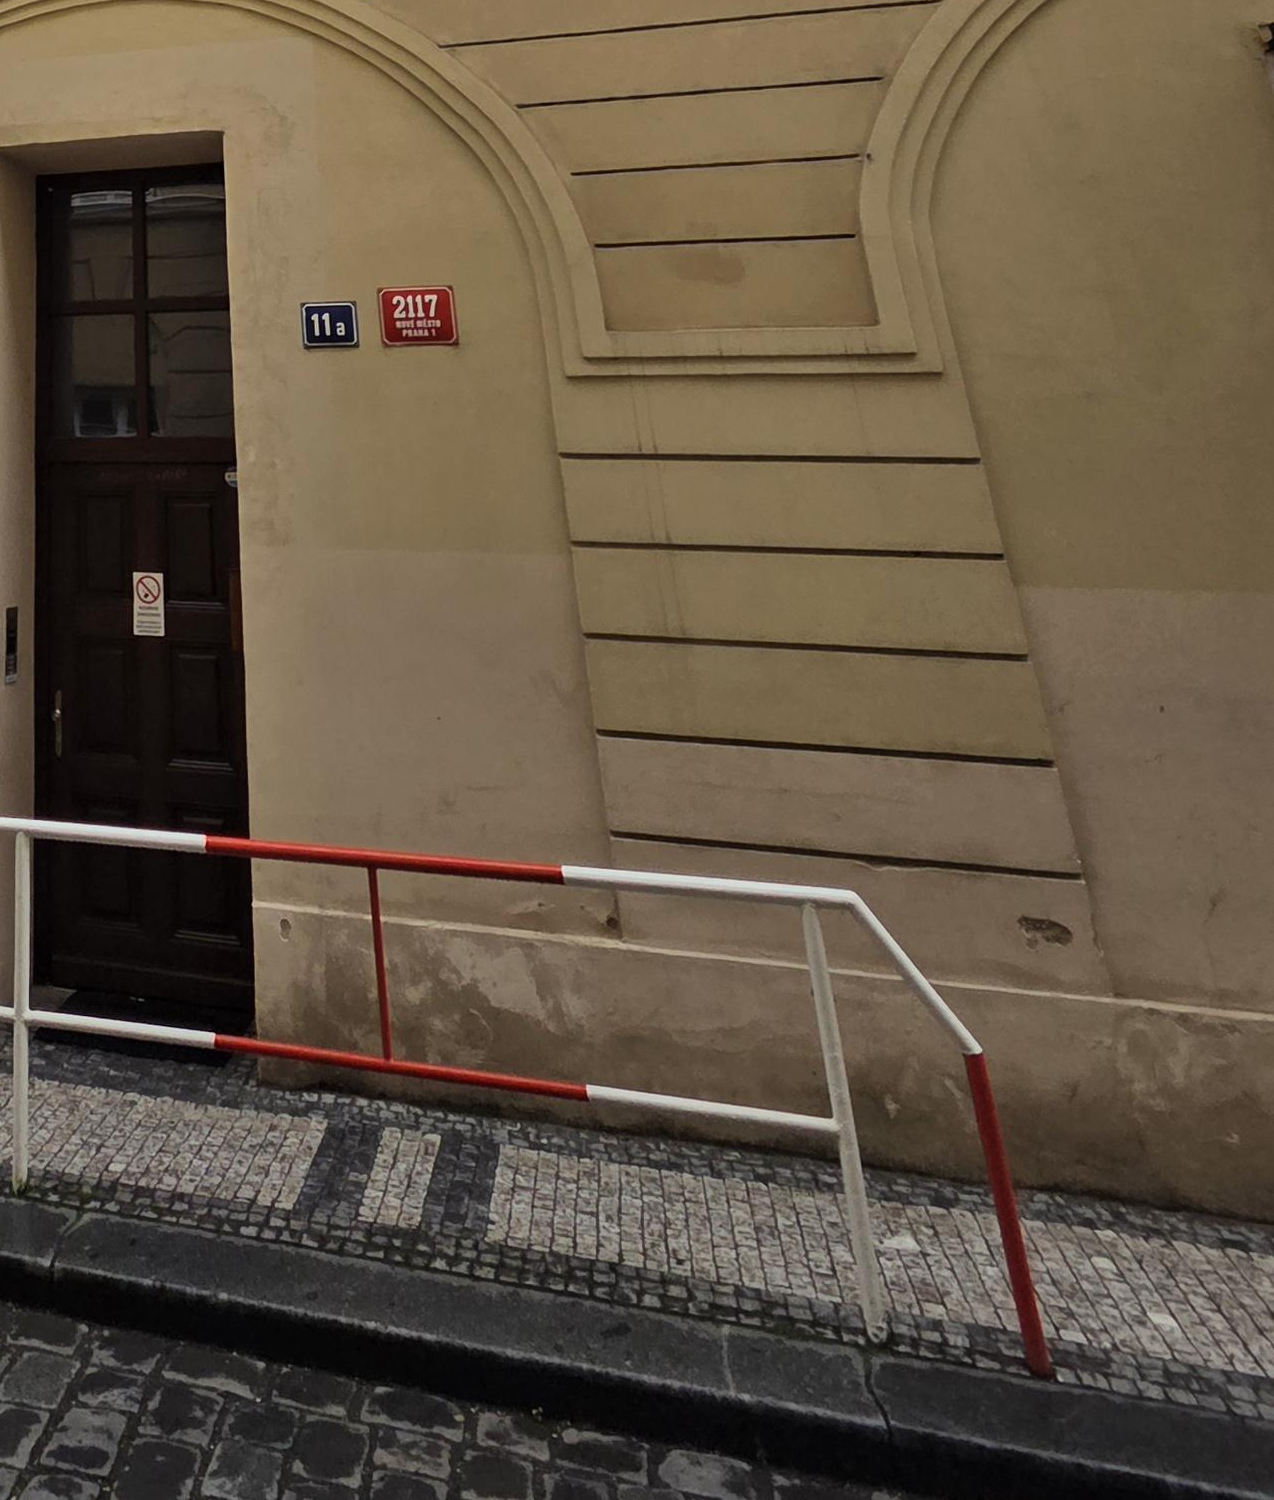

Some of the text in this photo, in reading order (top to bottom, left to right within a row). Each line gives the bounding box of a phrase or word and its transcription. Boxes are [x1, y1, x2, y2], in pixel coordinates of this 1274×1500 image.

[391, 294, 438, 319] 2117
[402, 329, 436, 338] PRAHA 1
